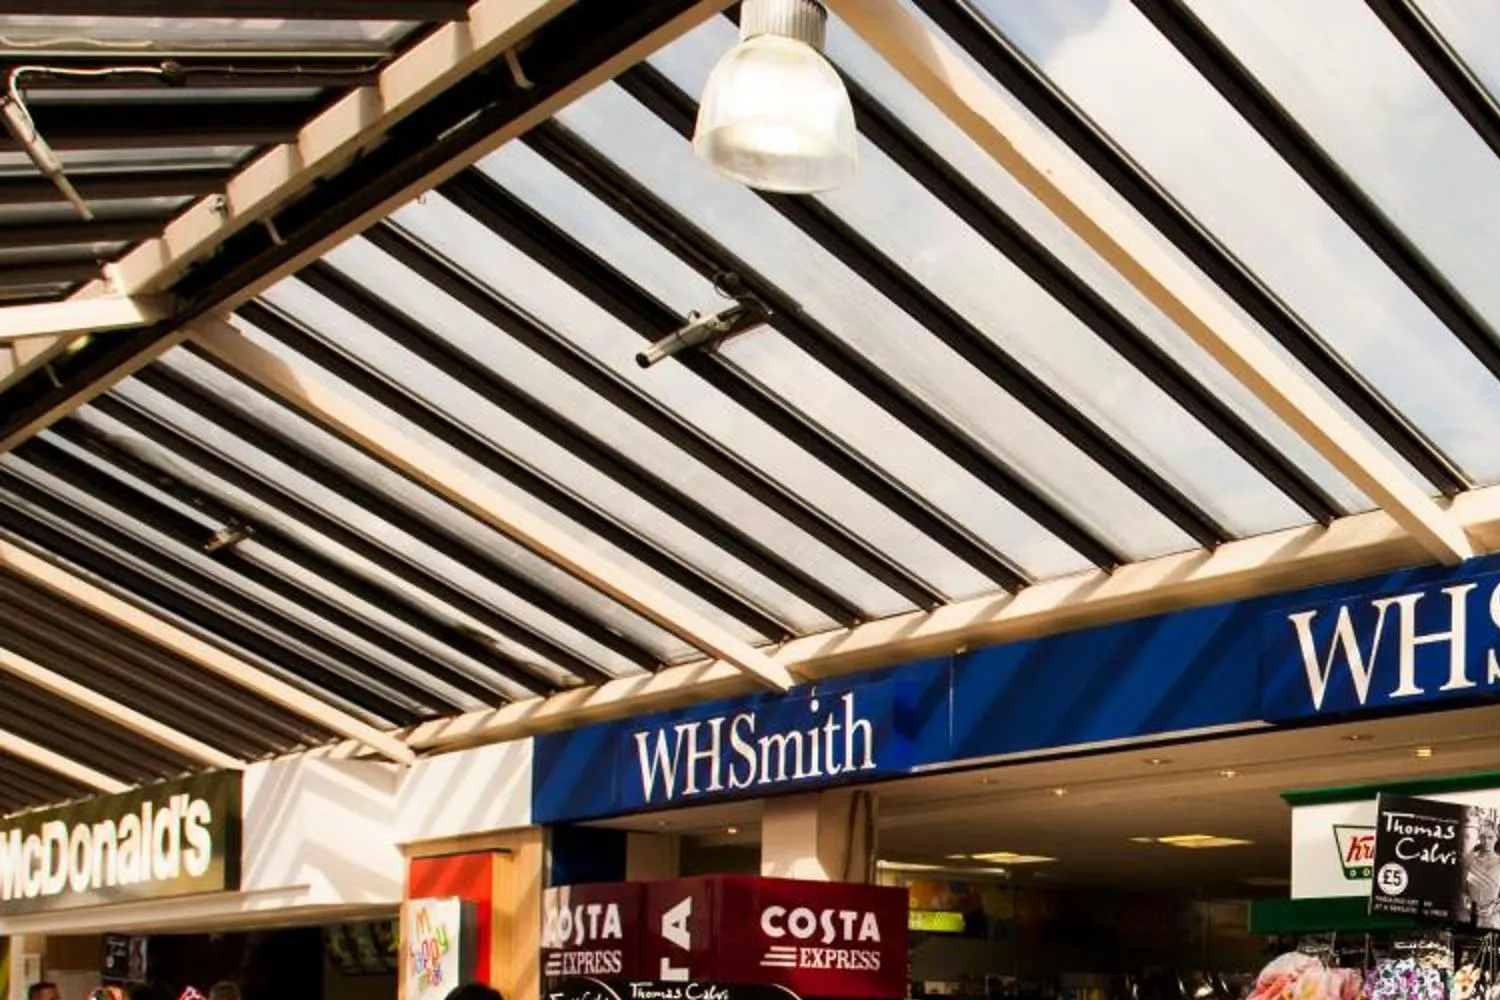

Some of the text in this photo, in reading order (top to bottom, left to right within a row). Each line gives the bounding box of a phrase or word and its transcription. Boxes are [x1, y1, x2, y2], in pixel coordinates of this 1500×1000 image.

[634, 693, 877, 802] WHSmith
[1382, 812, 1456, 839] Thomas
[0, 794, 212, 900] McDonald's
[1395, 837, 1456, 865] Calvi
[1382, 869, 1402, 886] £5
[761, 906, 881, 944] COSTA
[799, 948, 881, 971] EXPRESS
[629, 982, 729, 1000] Thomas Calvi
